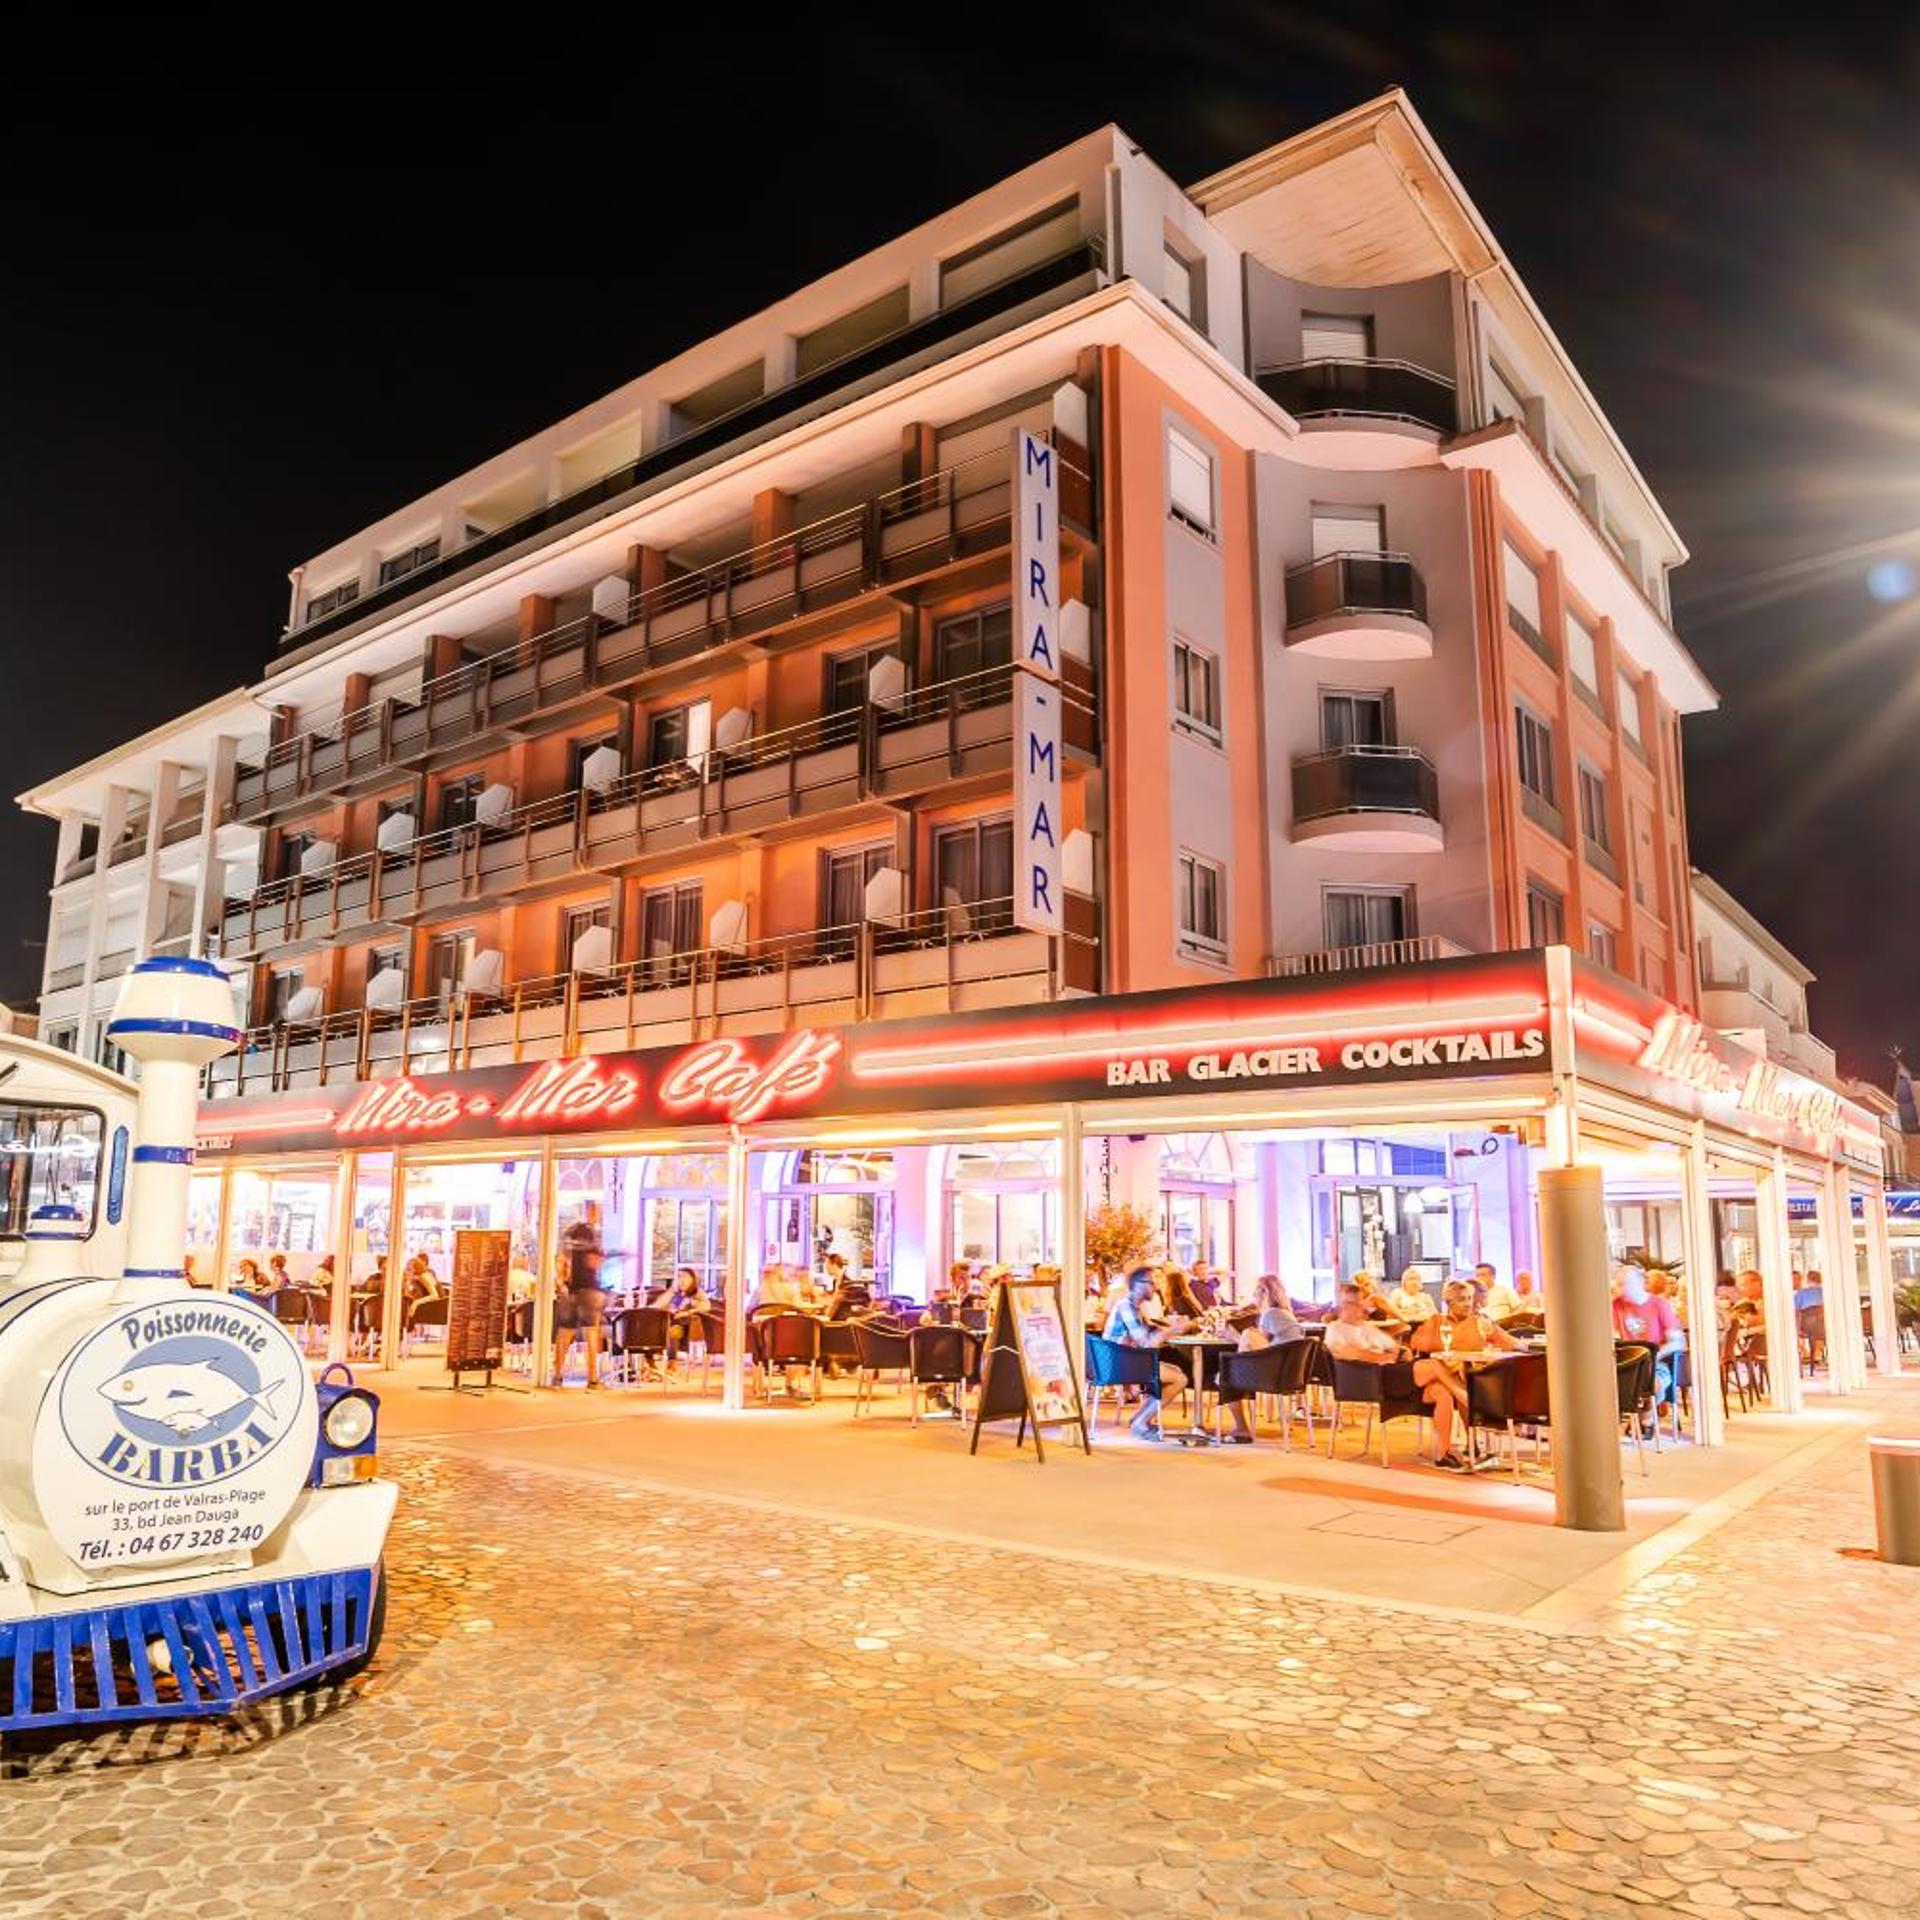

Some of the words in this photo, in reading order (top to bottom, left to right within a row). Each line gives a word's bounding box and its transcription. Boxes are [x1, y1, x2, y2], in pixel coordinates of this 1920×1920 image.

[1106, 1059, 1171, 1086] BAR
[1187, 1047, 1322, 1080] GLACIER
[1341, 1029, 1544, 1070] COCKTAILS
[335, 1078, 460, 1133] Mira
[496, 1057, 638, 1119] Mar
[659, 1030, 841, 1123] Café
[121, 1310, 268, 1353] Poissonnerie
[98, 1422, 274, 1484] BARBA
[85, 1503, 109, 1516] sur
[112, 1499, 125, 1513] le
[128, 1498, 160, 1516] port
[163, 1495, 181, 1509] de
[184, 1489, 266, 1507] Valras-Plage
[112, 1518, 134, 1532] 33,
[138, 1515, 156, 1530] bd
[160, 1511, 192, 1527] Jean
[196, 1509, 240, 1524] Dauga
[80, 1540, 112, 1561] Tél.
[130, 1536, 154, 1555] 04
[159, 1533, 184, 1551] 67
[188, 1528, 224, 1549] 328
[228, 1524, 263, 1544] 240
